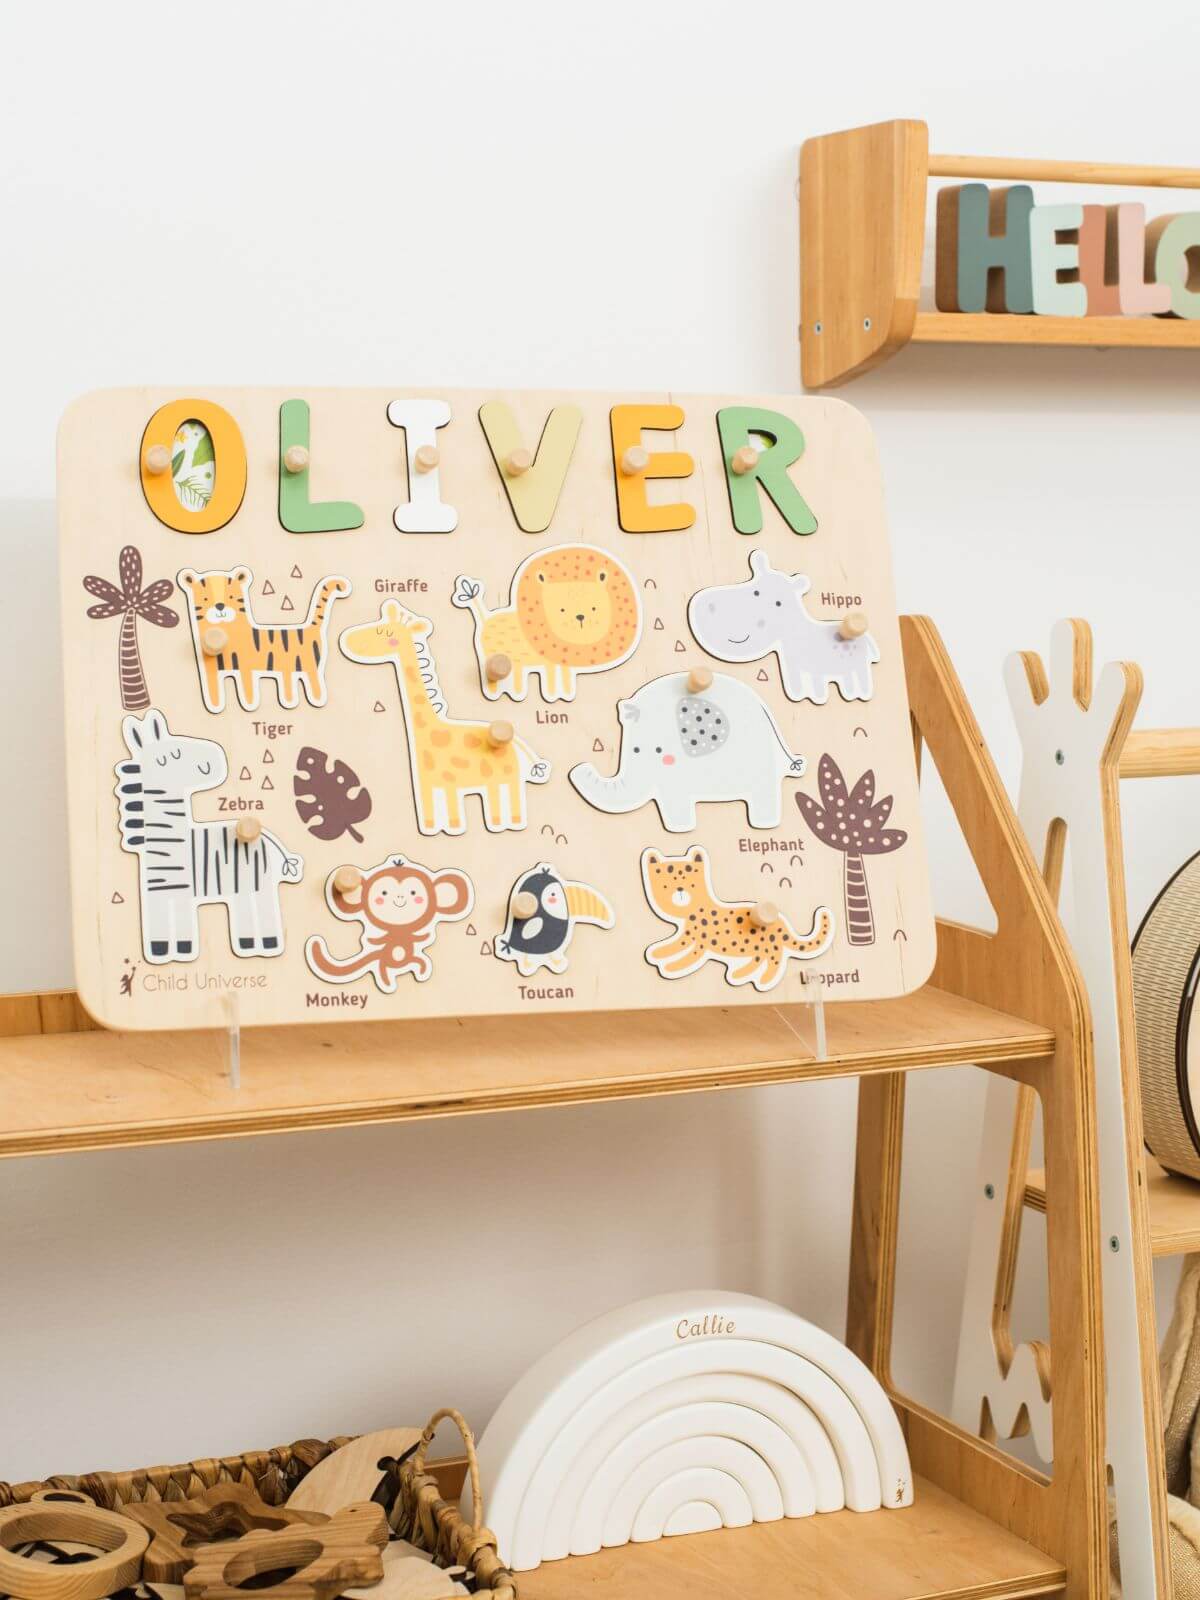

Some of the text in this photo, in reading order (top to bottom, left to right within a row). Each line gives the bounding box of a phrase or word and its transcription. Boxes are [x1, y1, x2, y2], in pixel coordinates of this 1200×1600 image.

[139, 397, 819, 536] OLIVER
[374, 578, 428, 593] Giraffe
[821, 592, 862, 608] Hippo
[535, 709, 569, 725] Lion
[252, 720, 293, 738] Tiger
[218, 796, 264, 812] Zebra
[738, 838, 805, 855] Elephant
[142, 971, 268, 992] Child Universe
[800, 968, 861, 987] Lopard
[306, 992, 369, 1009] Monkey
[518, 984, 575, 1000] Toucan
[676, 1315, 736, 1340] Callie
